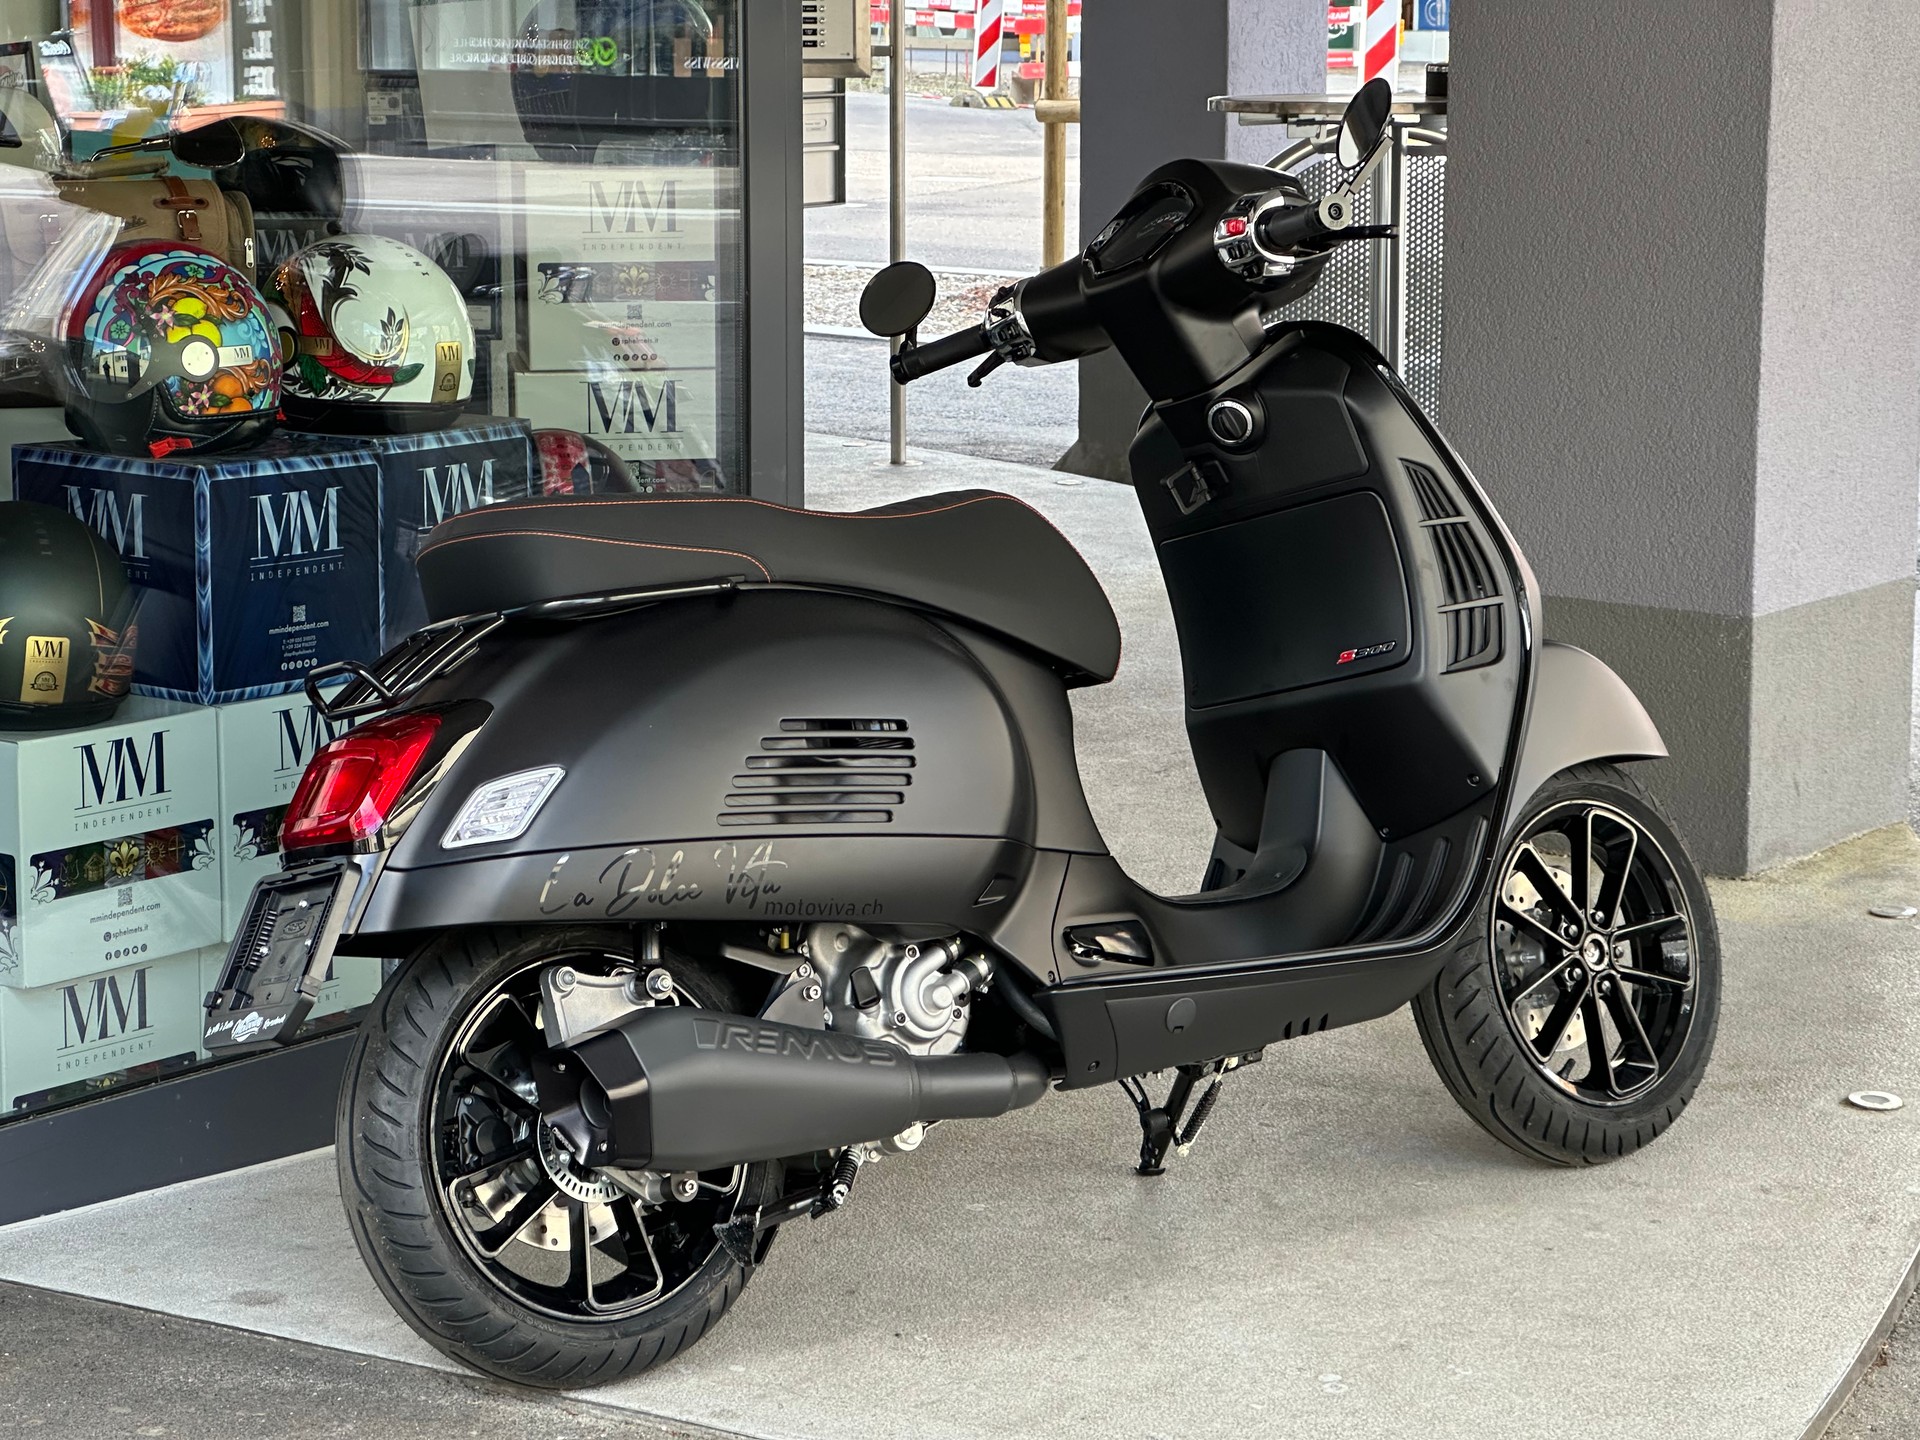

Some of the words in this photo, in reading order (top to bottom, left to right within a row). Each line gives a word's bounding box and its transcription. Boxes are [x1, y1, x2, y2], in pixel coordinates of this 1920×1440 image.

[581, 180, 684, 233] MM
[579, 380, 684, 434] MM
[609, 443, 682, 452] EPENDENT
[249, 486, 344, 561] MM
[31, 640, 65, 658] MM
[73, 730, 172, 811] MM
[75, 806, 171, 831] INDEPENDENT
[540, 853, 594, 914] La
[599, 847, 703, 917] Dolce
[90, 903, 161, 924] mmindependent.com
[764, 898, 883, 917] motoviva.ch
[112, 924, 149, 940] sphelmets.it
[56, 966, 154, 1051] MM
[57, 1040, 153, 1071] INDEPENDENT
[722, 1022, 897, 1067] REMUS
